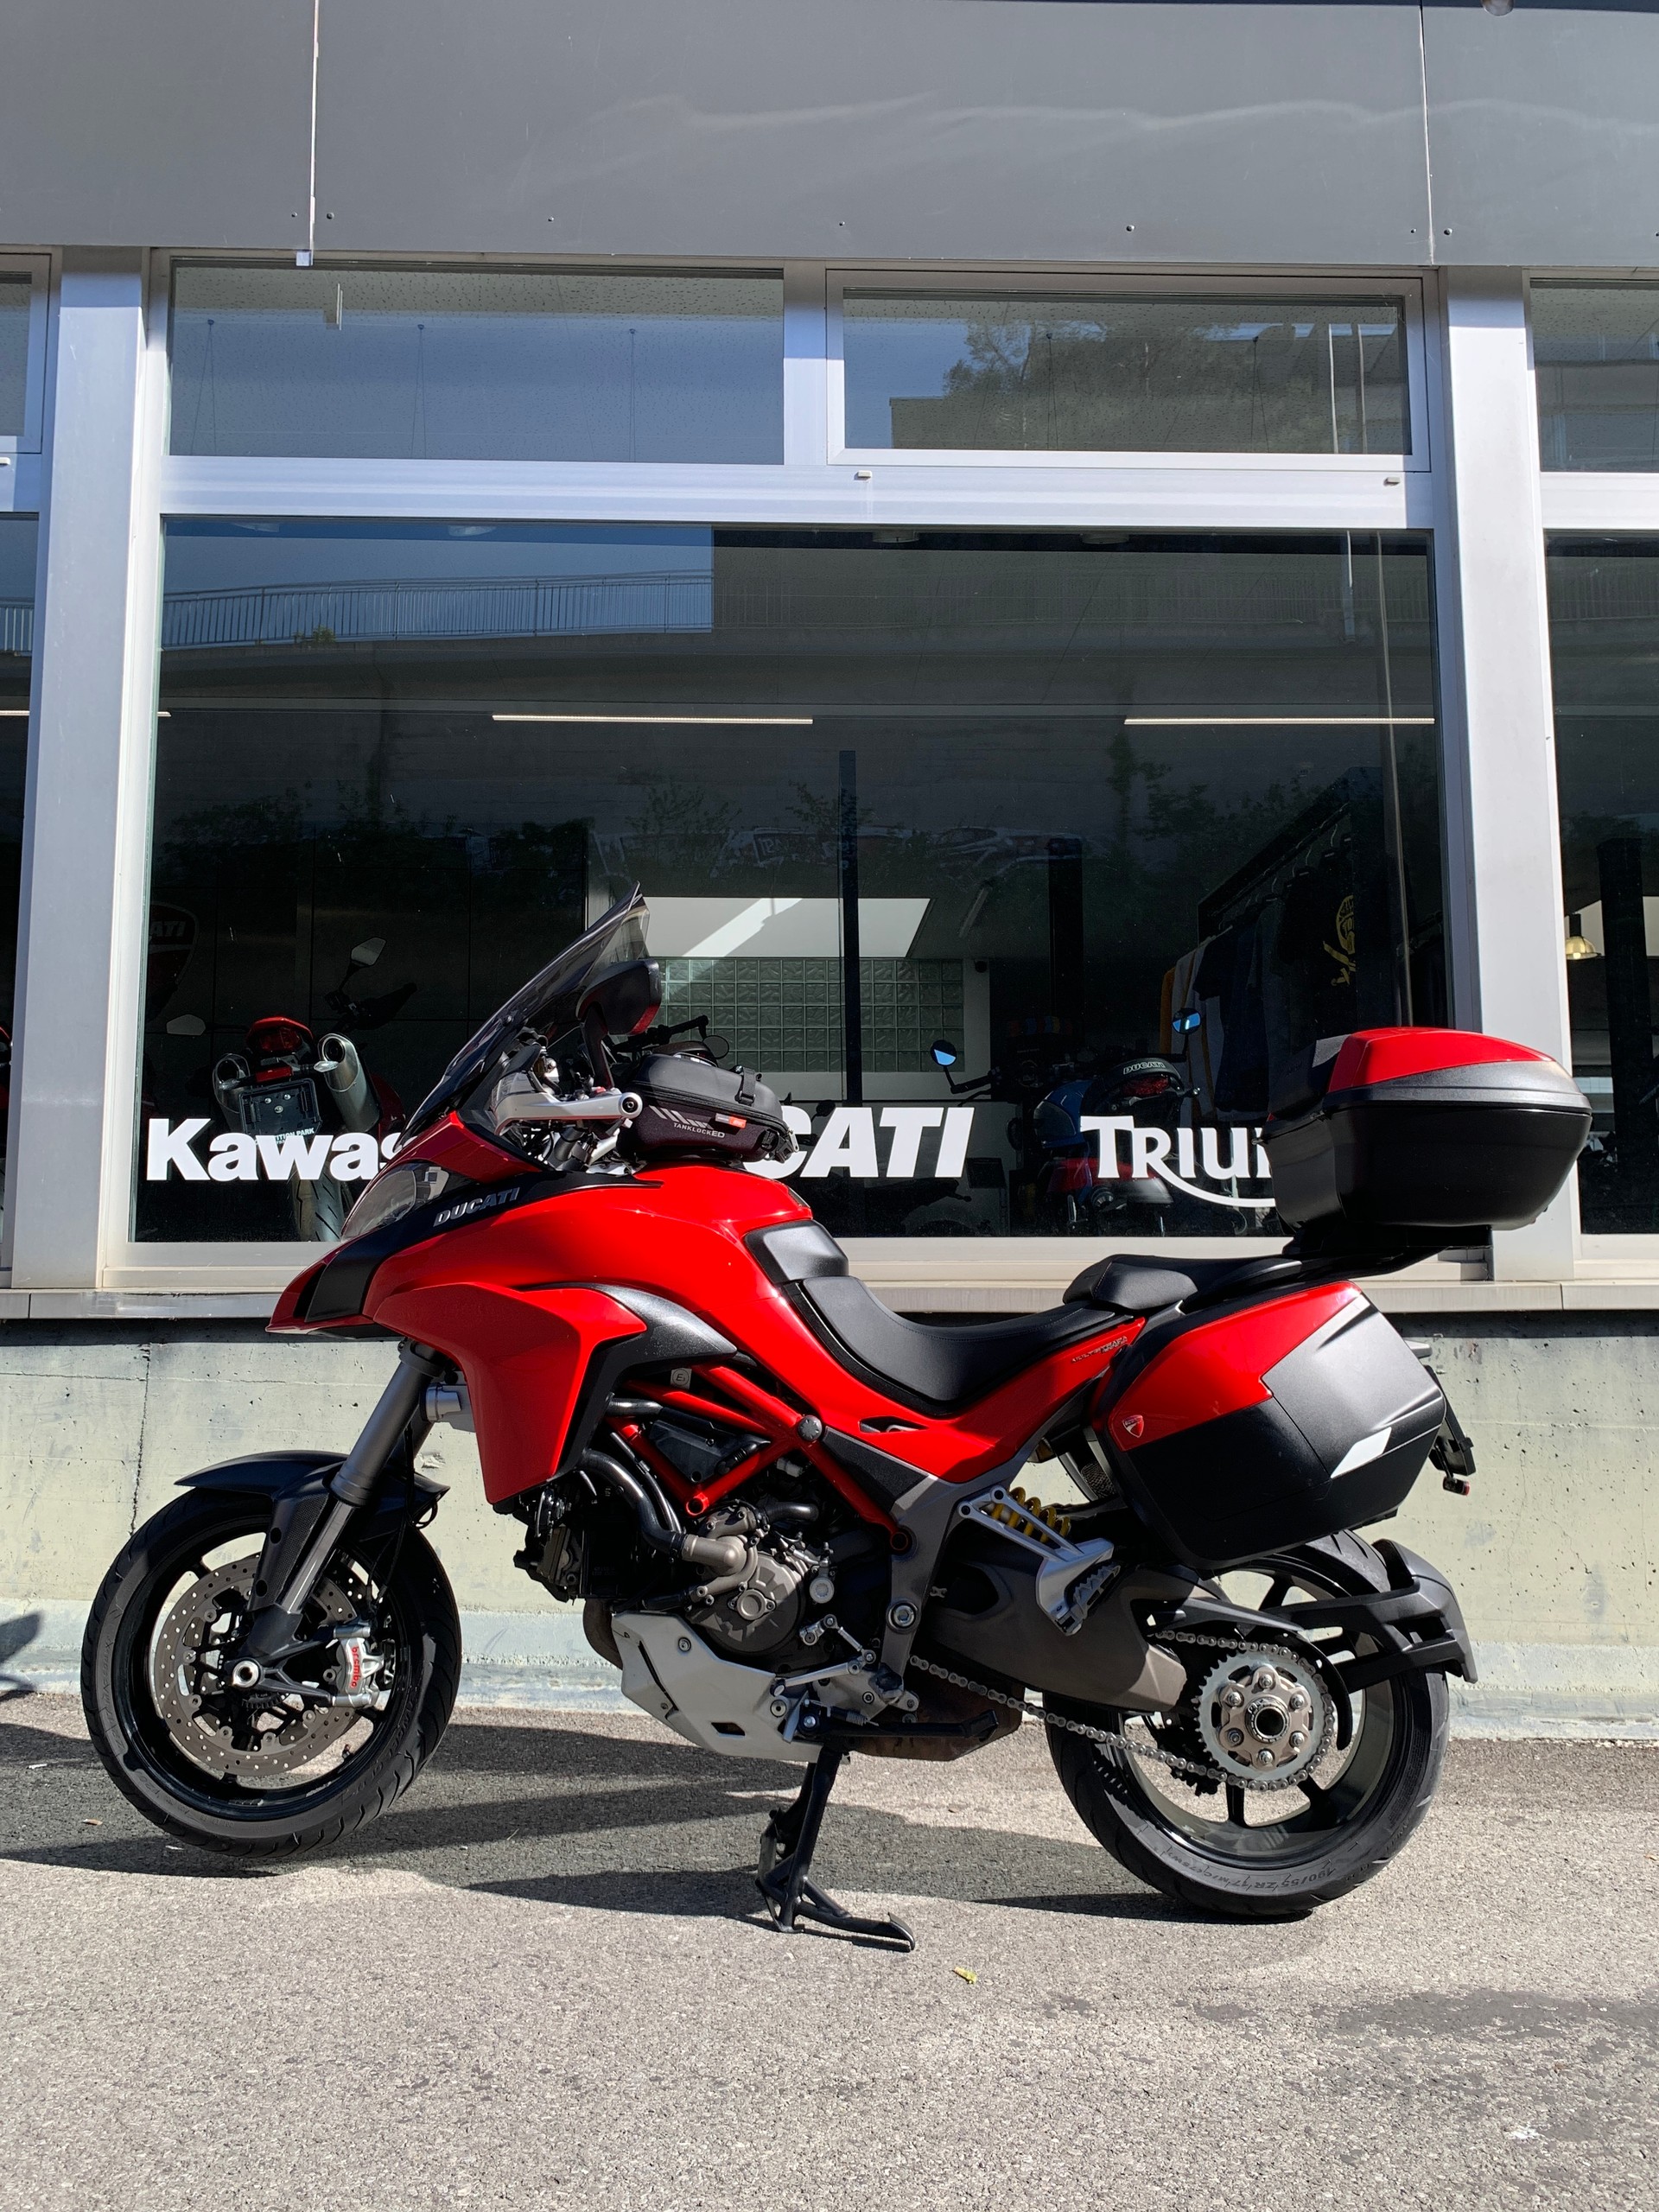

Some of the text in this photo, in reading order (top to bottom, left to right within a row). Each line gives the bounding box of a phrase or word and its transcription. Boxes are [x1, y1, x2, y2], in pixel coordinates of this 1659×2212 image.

[1123, 1062, 1166, 1075] DUCATI
[296, 1128, 315, 1136] PARK
[674, 1123, 725, 1138] TANKLOCKED
[433, 1187, 520, 1227] DUCATI
[350, 1645, 362, 1688] brembo
